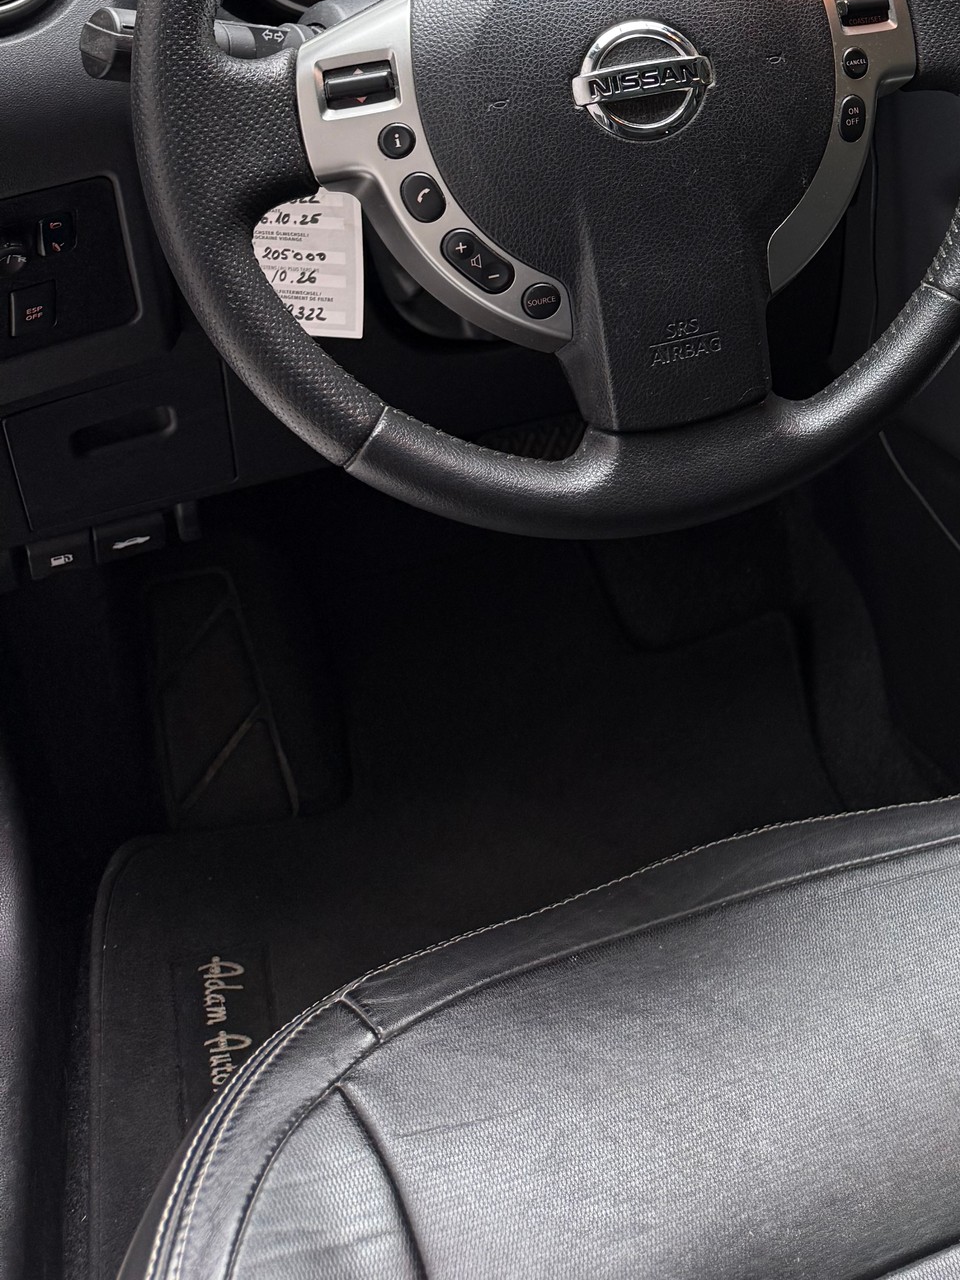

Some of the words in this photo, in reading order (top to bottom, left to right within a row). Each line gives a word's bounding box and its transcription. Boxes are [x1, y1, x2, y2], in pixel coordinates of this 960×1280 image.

[588, 62, 700, 99] NISSAN
[848, 107, 860, 116] ON
[845, 118, 860, 126] OFF
[527, 295, 556, 307] SOURCE
[26, 305, 43, 315] ESP
[26, 312, 43, 321] OFF
[666, 318, 700, 340] SRS
[651, 337, 722, 367] AIRBAG
[198, 956, 245, 1025] Adam
[204, 1031, 252, 1092] Auto
